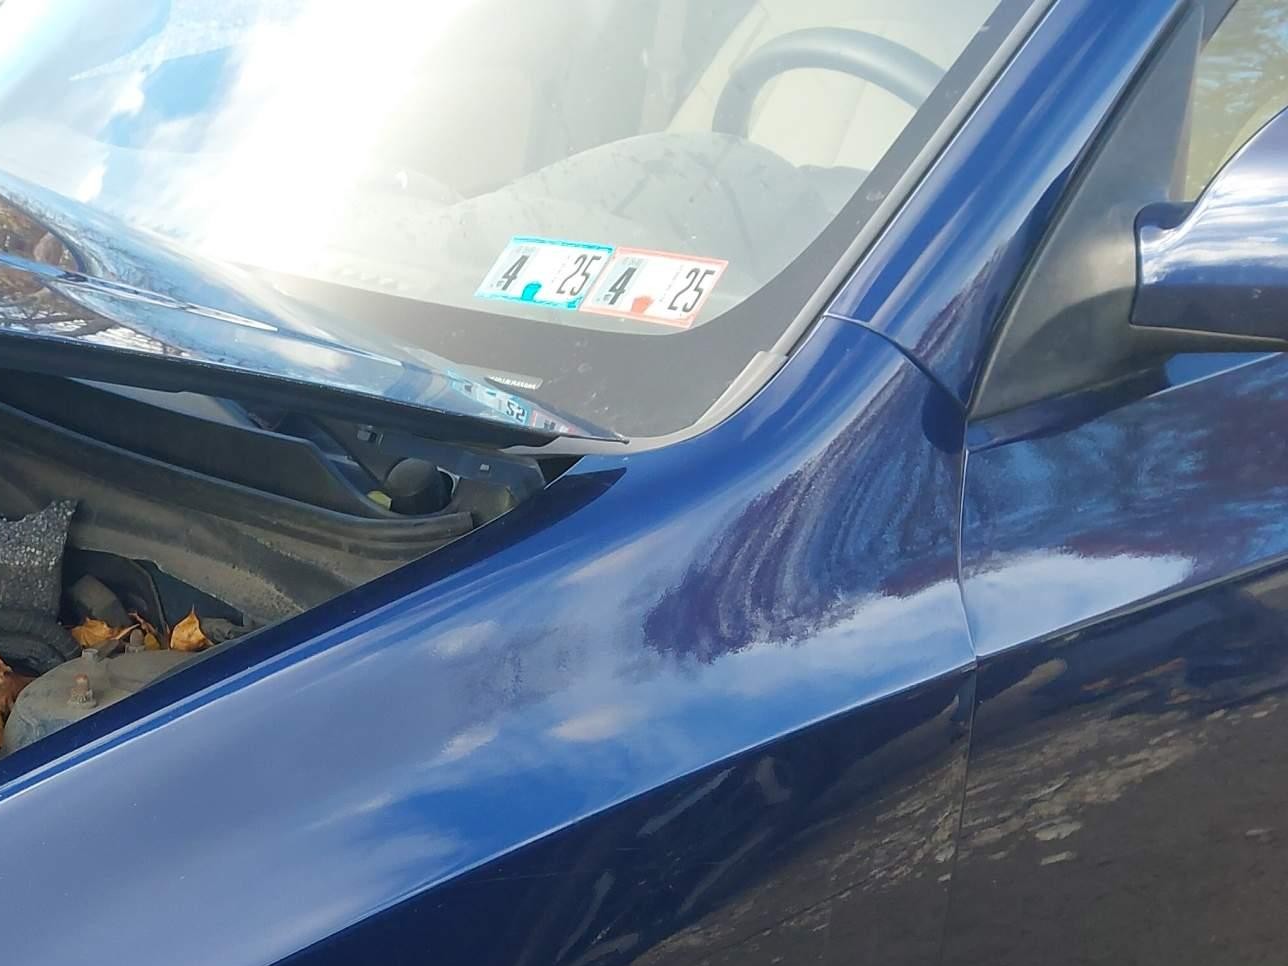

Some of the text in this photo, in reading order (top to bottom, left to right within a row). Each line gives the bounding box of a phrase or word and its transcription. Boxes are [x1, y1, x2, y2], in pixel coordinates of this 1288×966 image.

[502, 254, 601, 296] 4 25
[608, 267, 716, 313] 4 25
